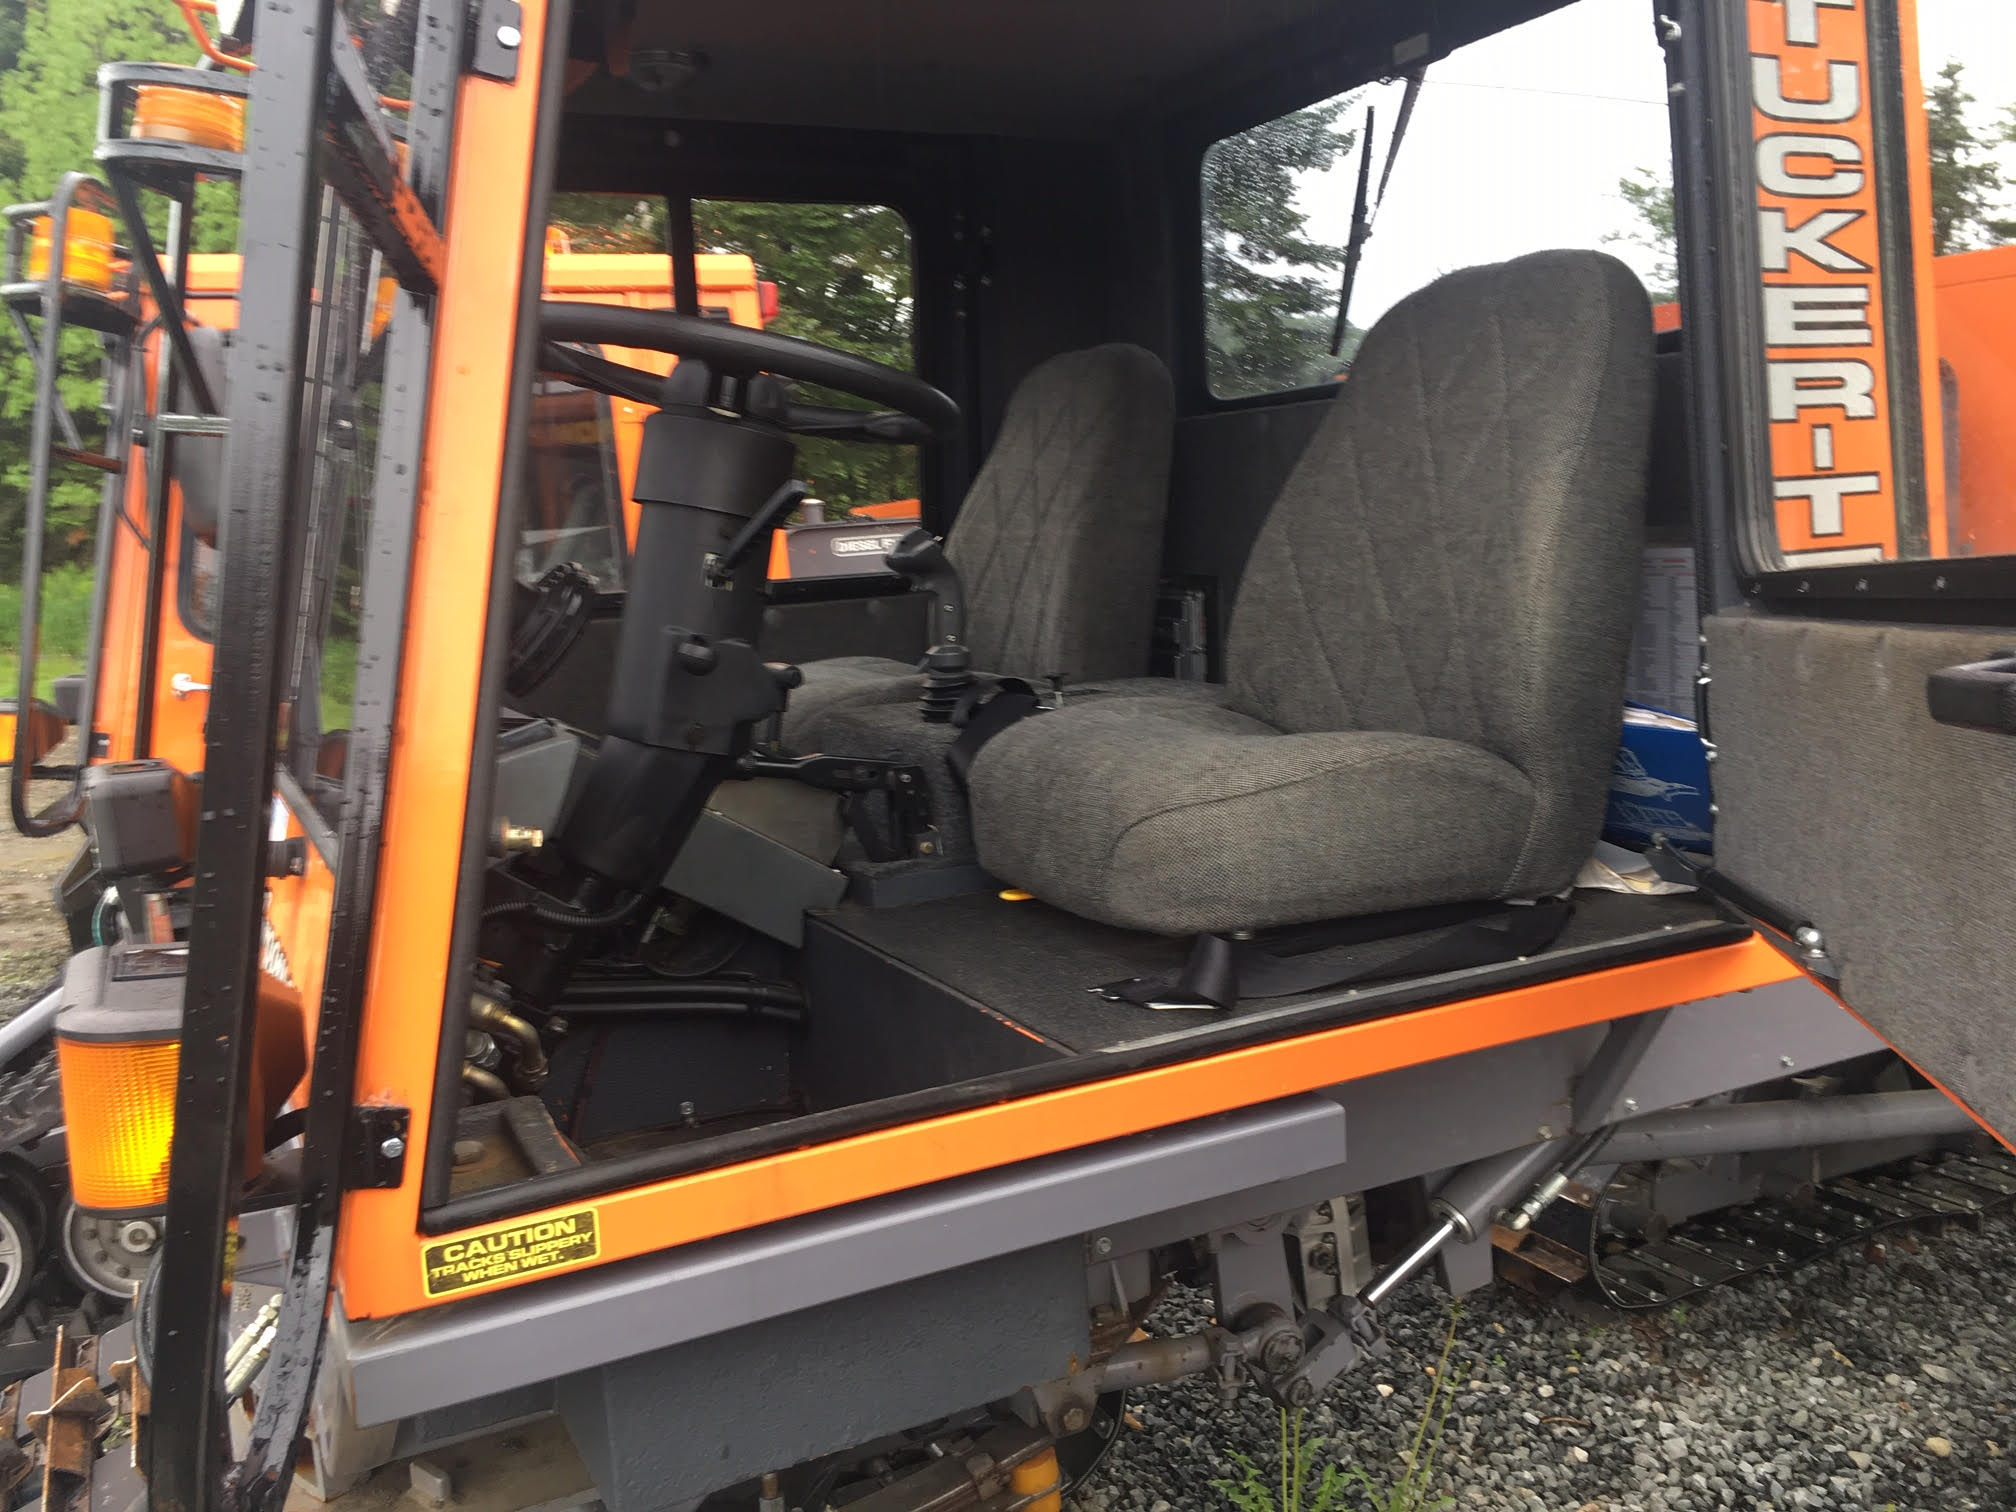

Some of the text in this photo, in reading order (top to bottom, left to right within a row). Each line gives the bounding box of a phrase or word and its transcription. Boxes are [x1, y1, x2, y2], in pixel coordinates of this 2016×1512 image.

[1750, 0, 1882, 570] TUCKER-T
[430, 1231, 593, 1279] TRACKS SLIPPERY
[443, 1218, 577, 1263] CAUTION
[462, 1250, 565, 1283] WHEN WET.
